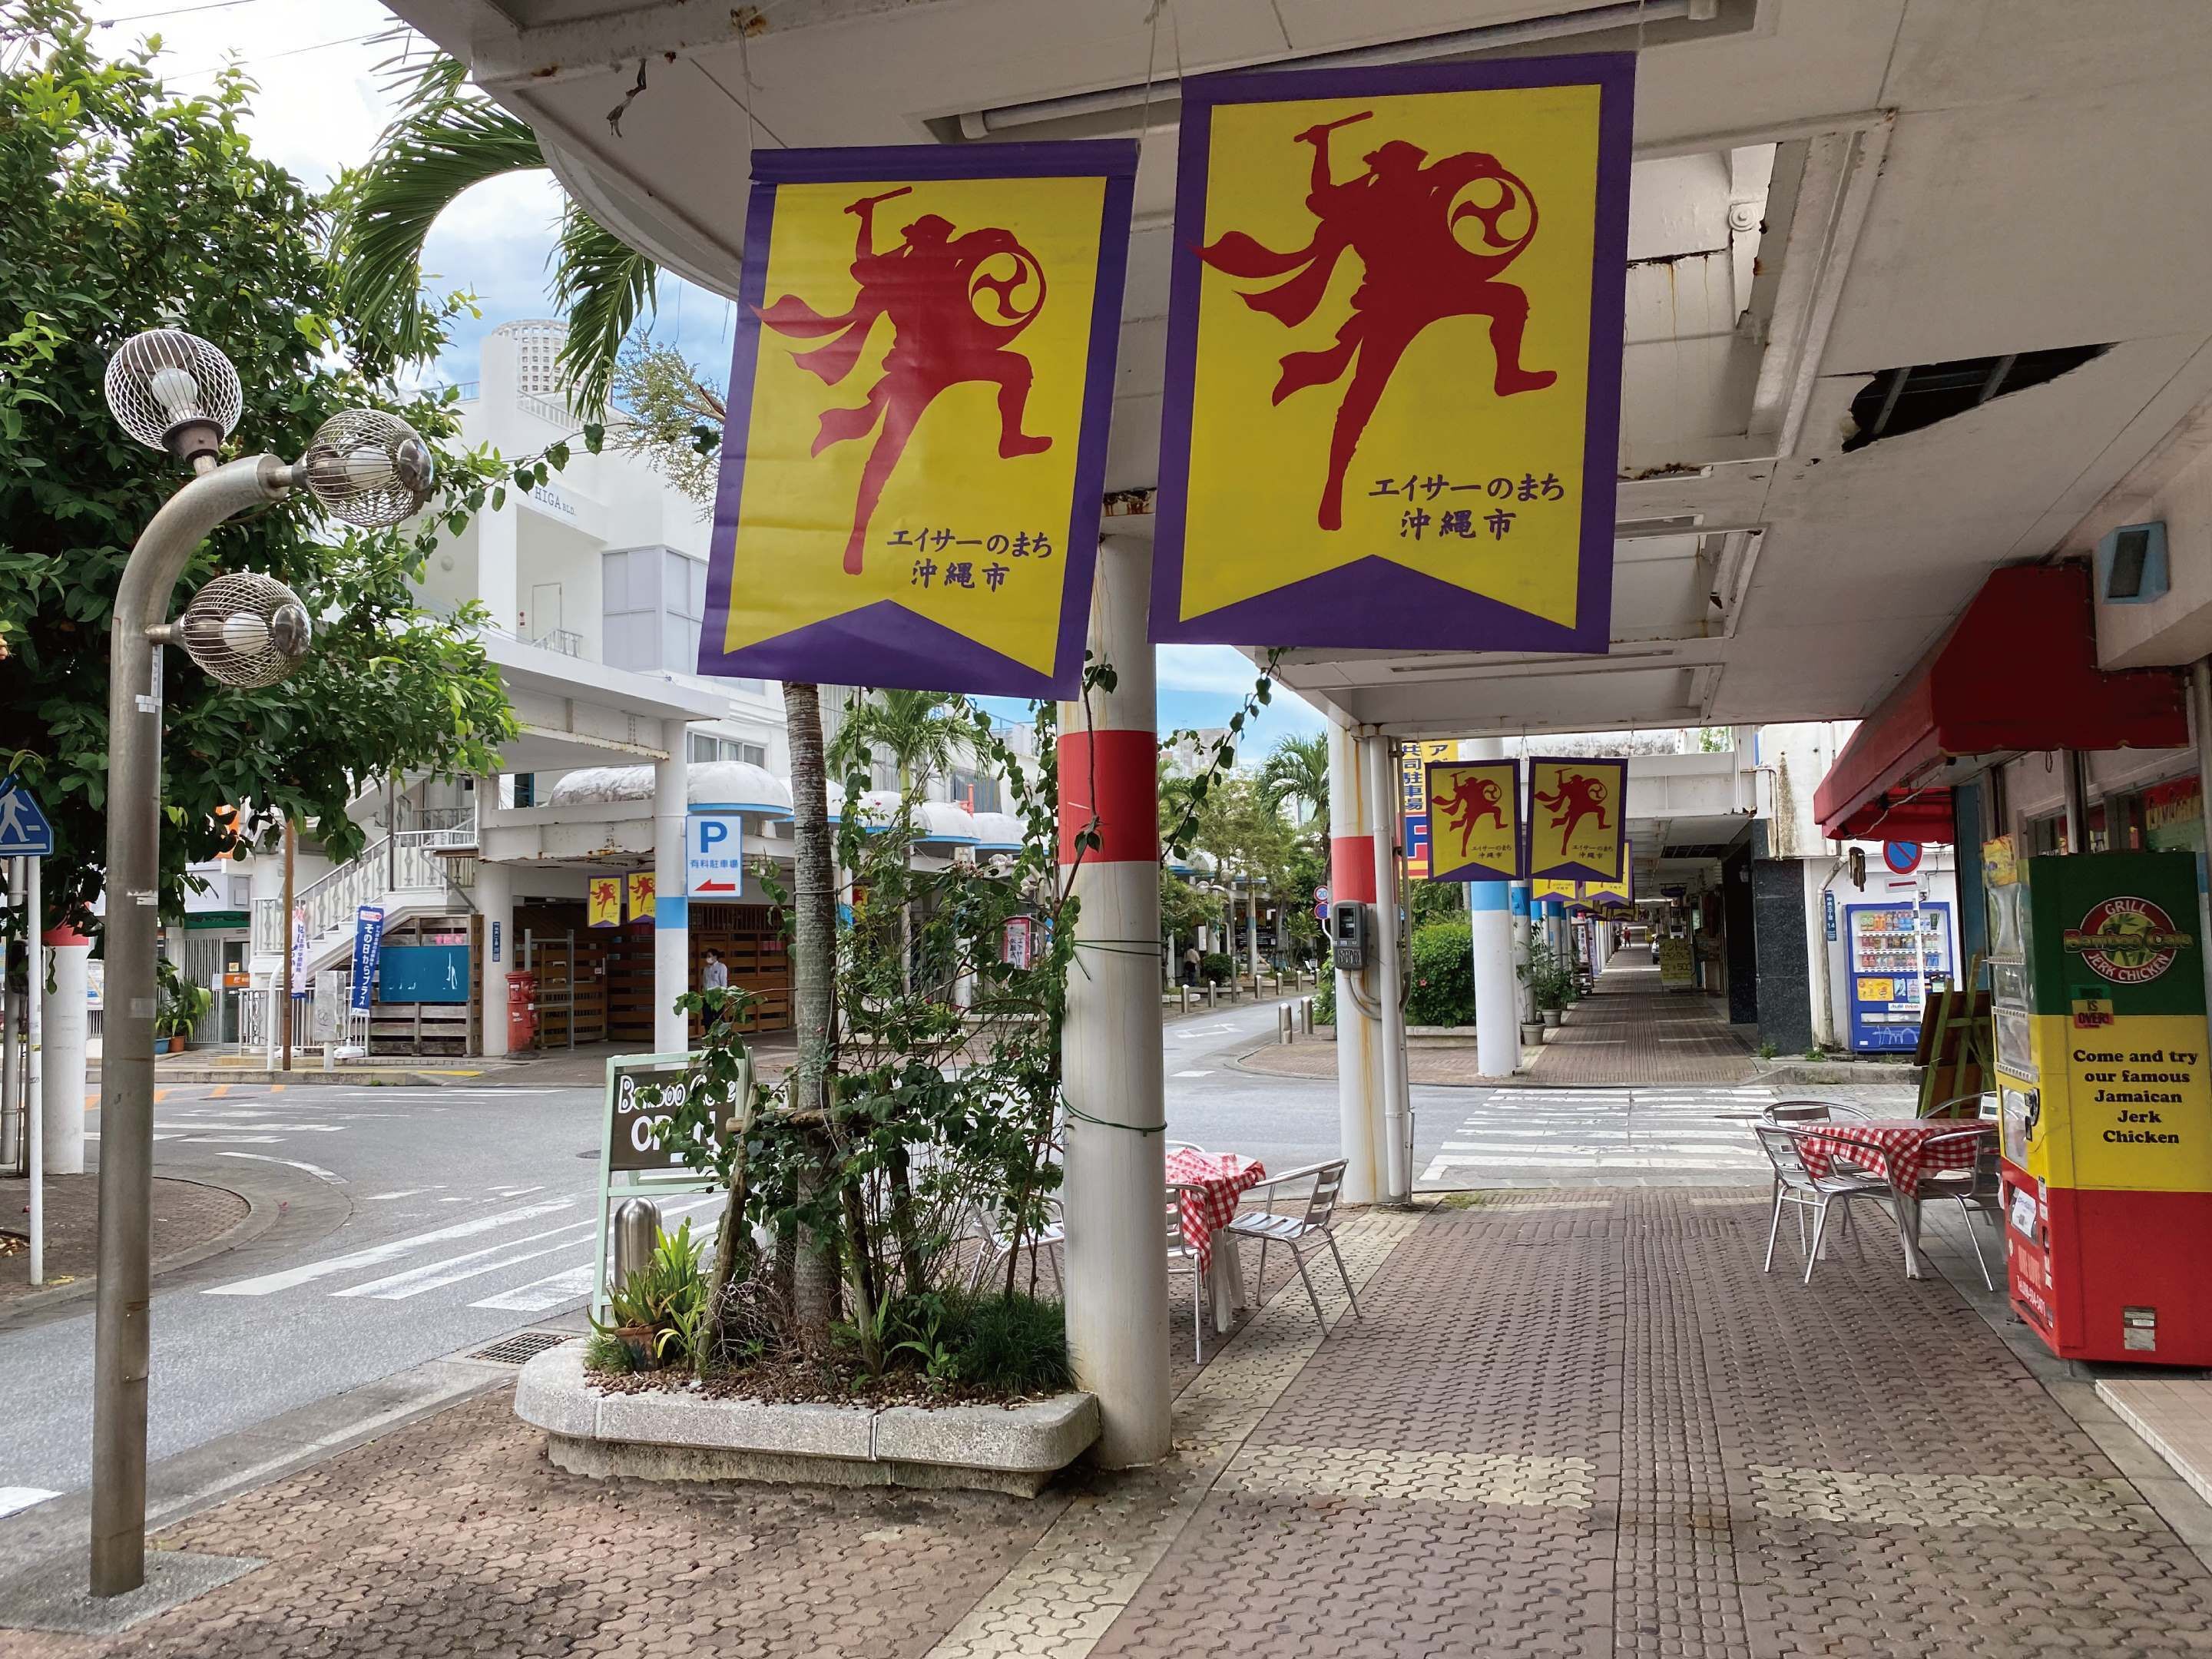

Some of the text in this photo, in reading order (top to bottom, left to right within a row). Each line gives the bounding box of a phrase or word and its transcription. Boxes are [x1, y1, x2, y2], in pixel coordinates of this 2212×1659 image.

[1368, 472, 1565, 502] エイサーのまち
[535, 486, 576, 517] HIGA BLD.
[1399, 507, 1517, 541] 沖縄市
[886, 528, 1052, 558] エイサーのまち
[911, 558, 1010, 593] 沖縄市
[700, 821, 728, 853] P
[2104, 899, 2147, 916] GRILL
[2064, 929, 2143, 953] Bamboo
[2088, 952, 2168, 981] JERK CHICKEN
[2073, 1049, 2198, 1065] Come and try
[2085, 1070, 2190, 1083] our famous
[2094, 1089, 2183, 1103] Jamaican
[2118, 1110, 2162, 1123] Jerk
[2103, 1130, 2180, 1144] Chicken
